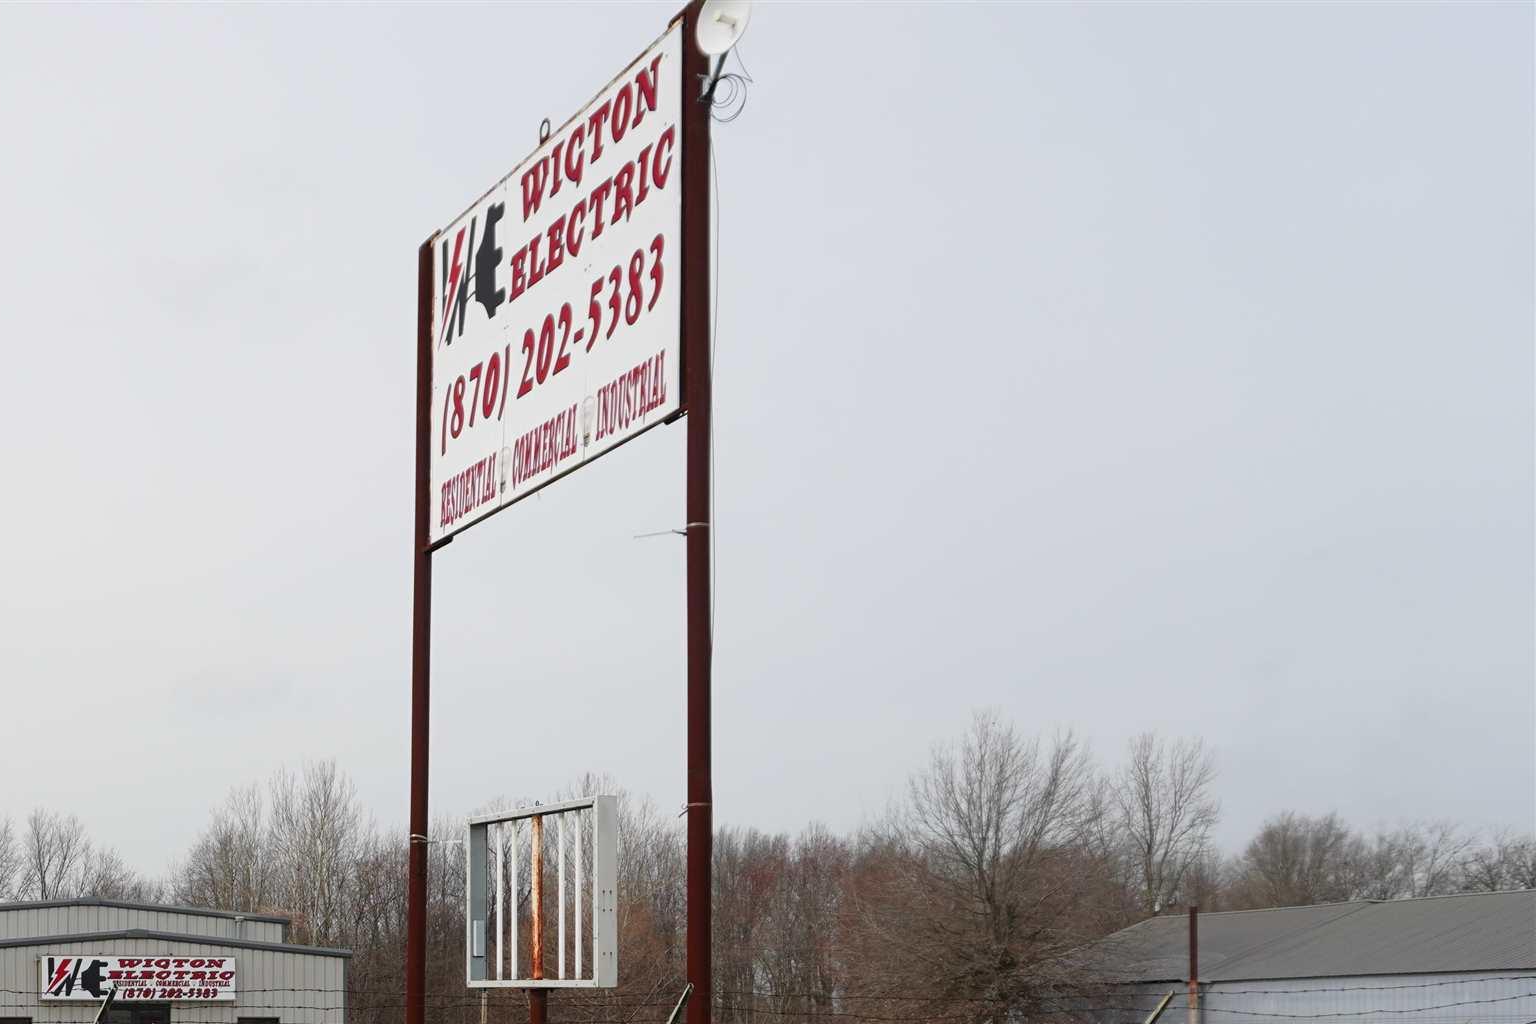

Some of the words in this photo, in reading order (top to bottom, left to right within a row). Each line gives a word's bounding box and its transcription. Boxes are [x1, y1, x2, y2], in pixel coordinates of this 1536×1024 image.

[520, 51, 664, 224] WIGTON
[509, 122, 676, 304] ELECTRIC
[441, 343, 511, 457] (870)
[516, 232, 665, 400] 202-5383
[440, 451, 498, 528] RESIDENTIAL
[511, 402, 579, 491] COMMERCIAL
[595, 347, 667, 442] INDUSTRIAL
[107, 970, 235, 980] ELECTRIC
[118, 958, 226, 970] WIGTON
[123, 988, 156, 999] (870)
[159, 988, 219, 999] 202-5383
[155, 980, 190, 988] COMMERCIAL
[198, 980, 231, 988] INDUSTRIAL
